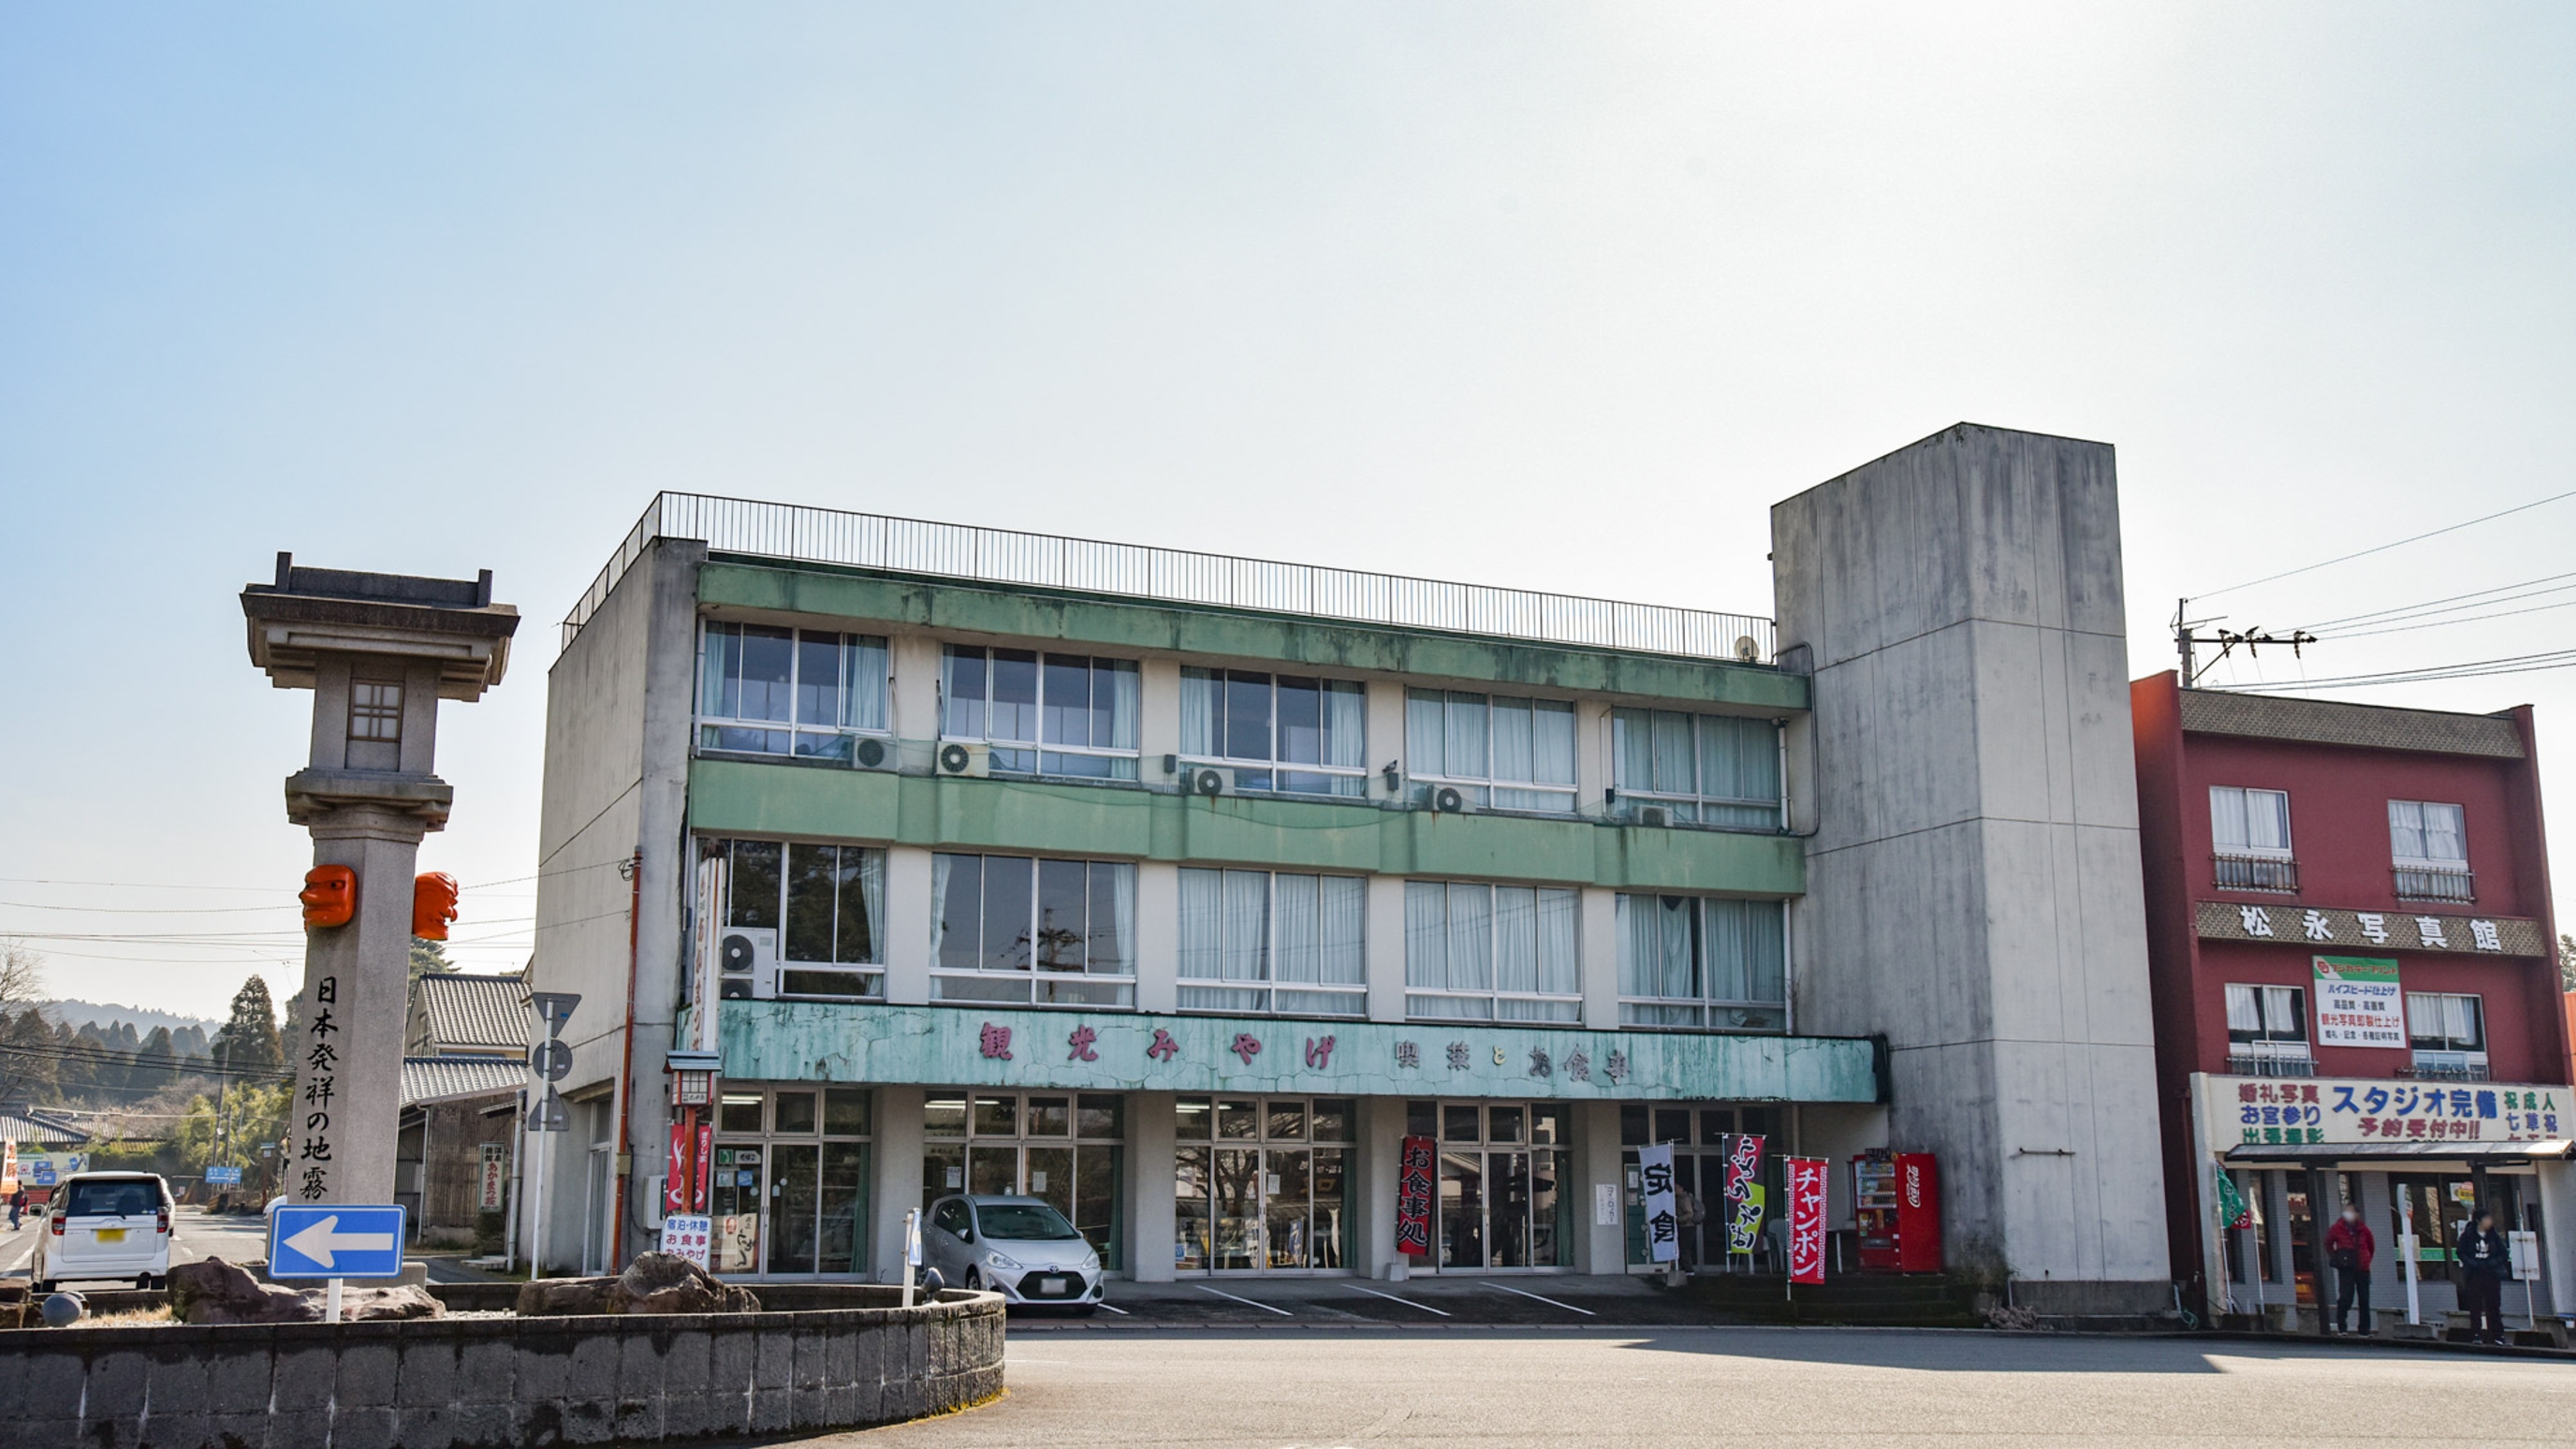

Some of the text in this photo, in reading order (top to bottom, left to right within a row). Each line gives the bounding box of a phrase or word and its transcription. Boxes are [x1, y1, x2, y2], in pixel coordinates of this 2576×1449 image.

[2239, 905, 2502, 951] 松永写真館
[2330, 963, 2397, 974] フジカラープリント
[2328, 984, 2397, 996] ハイスピード仕上げ
[979, 1021, 1631, 1086] 観光みやげ 喫茶とお食事
[300, 976, 339, 1200] 日本発祥の地霧
[2238, 1083, 2320, 1105] 婚礼写真
[2332, 1085, 2497, 1120] スタジオ完備
[2504, 1090, 2556, 1112] 祝成人
[2240, 1105, 2321, 1126] お宮参り
[2506, 1112, 2558, 1133] 七草祝
[2243, 1127, 2325, 1144] 出張撮影
[1398, 1145, 1432, 1246] お食事処
[667, 1219, 708, 1232] 宿泊・休憩
[1793, 1167, 1821, 1276] チャンポン
[666, 1234, 707, 1246] お食事
